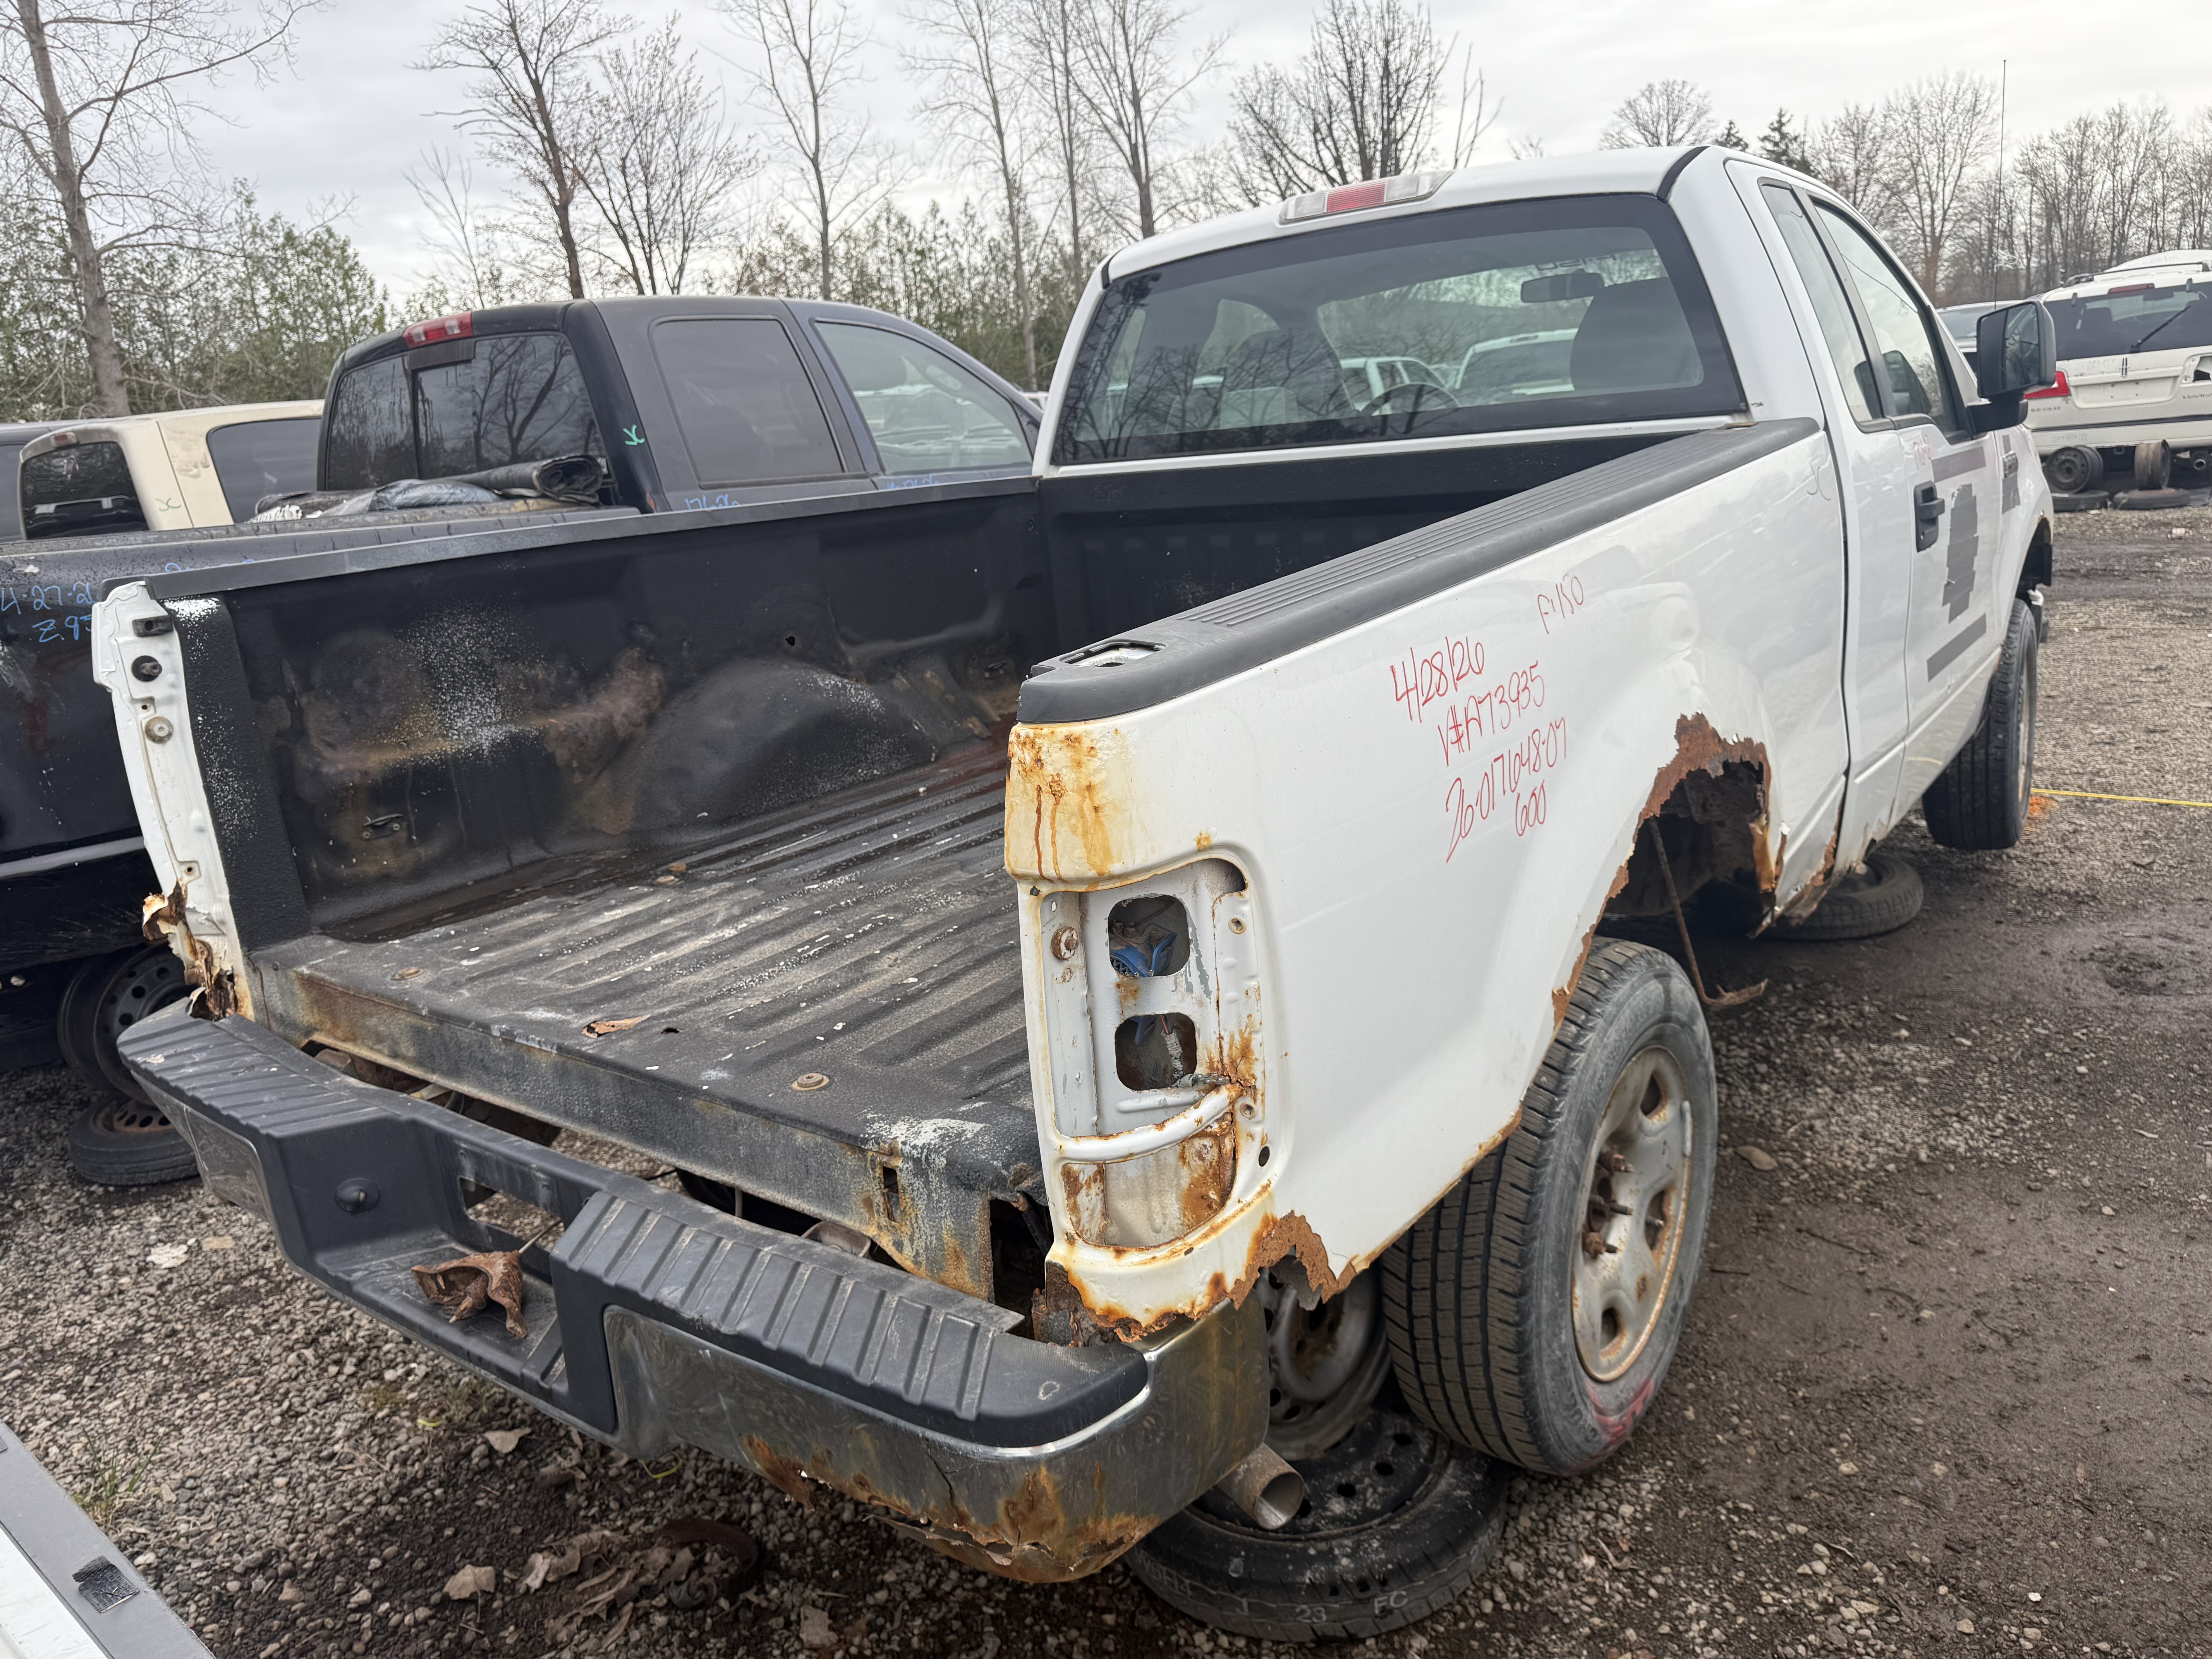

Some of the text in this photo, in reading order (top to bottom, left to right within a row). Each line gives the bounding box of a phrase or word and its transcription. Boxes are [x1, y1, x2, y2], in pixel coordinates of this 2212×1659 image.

[1, 581, 96, 615] 4-27-2
[1390, 636, 1485, 724] 4/28/26
[1515, 779, 1546, 836] 600
[1294, 1604, 1327, 1623] 23
